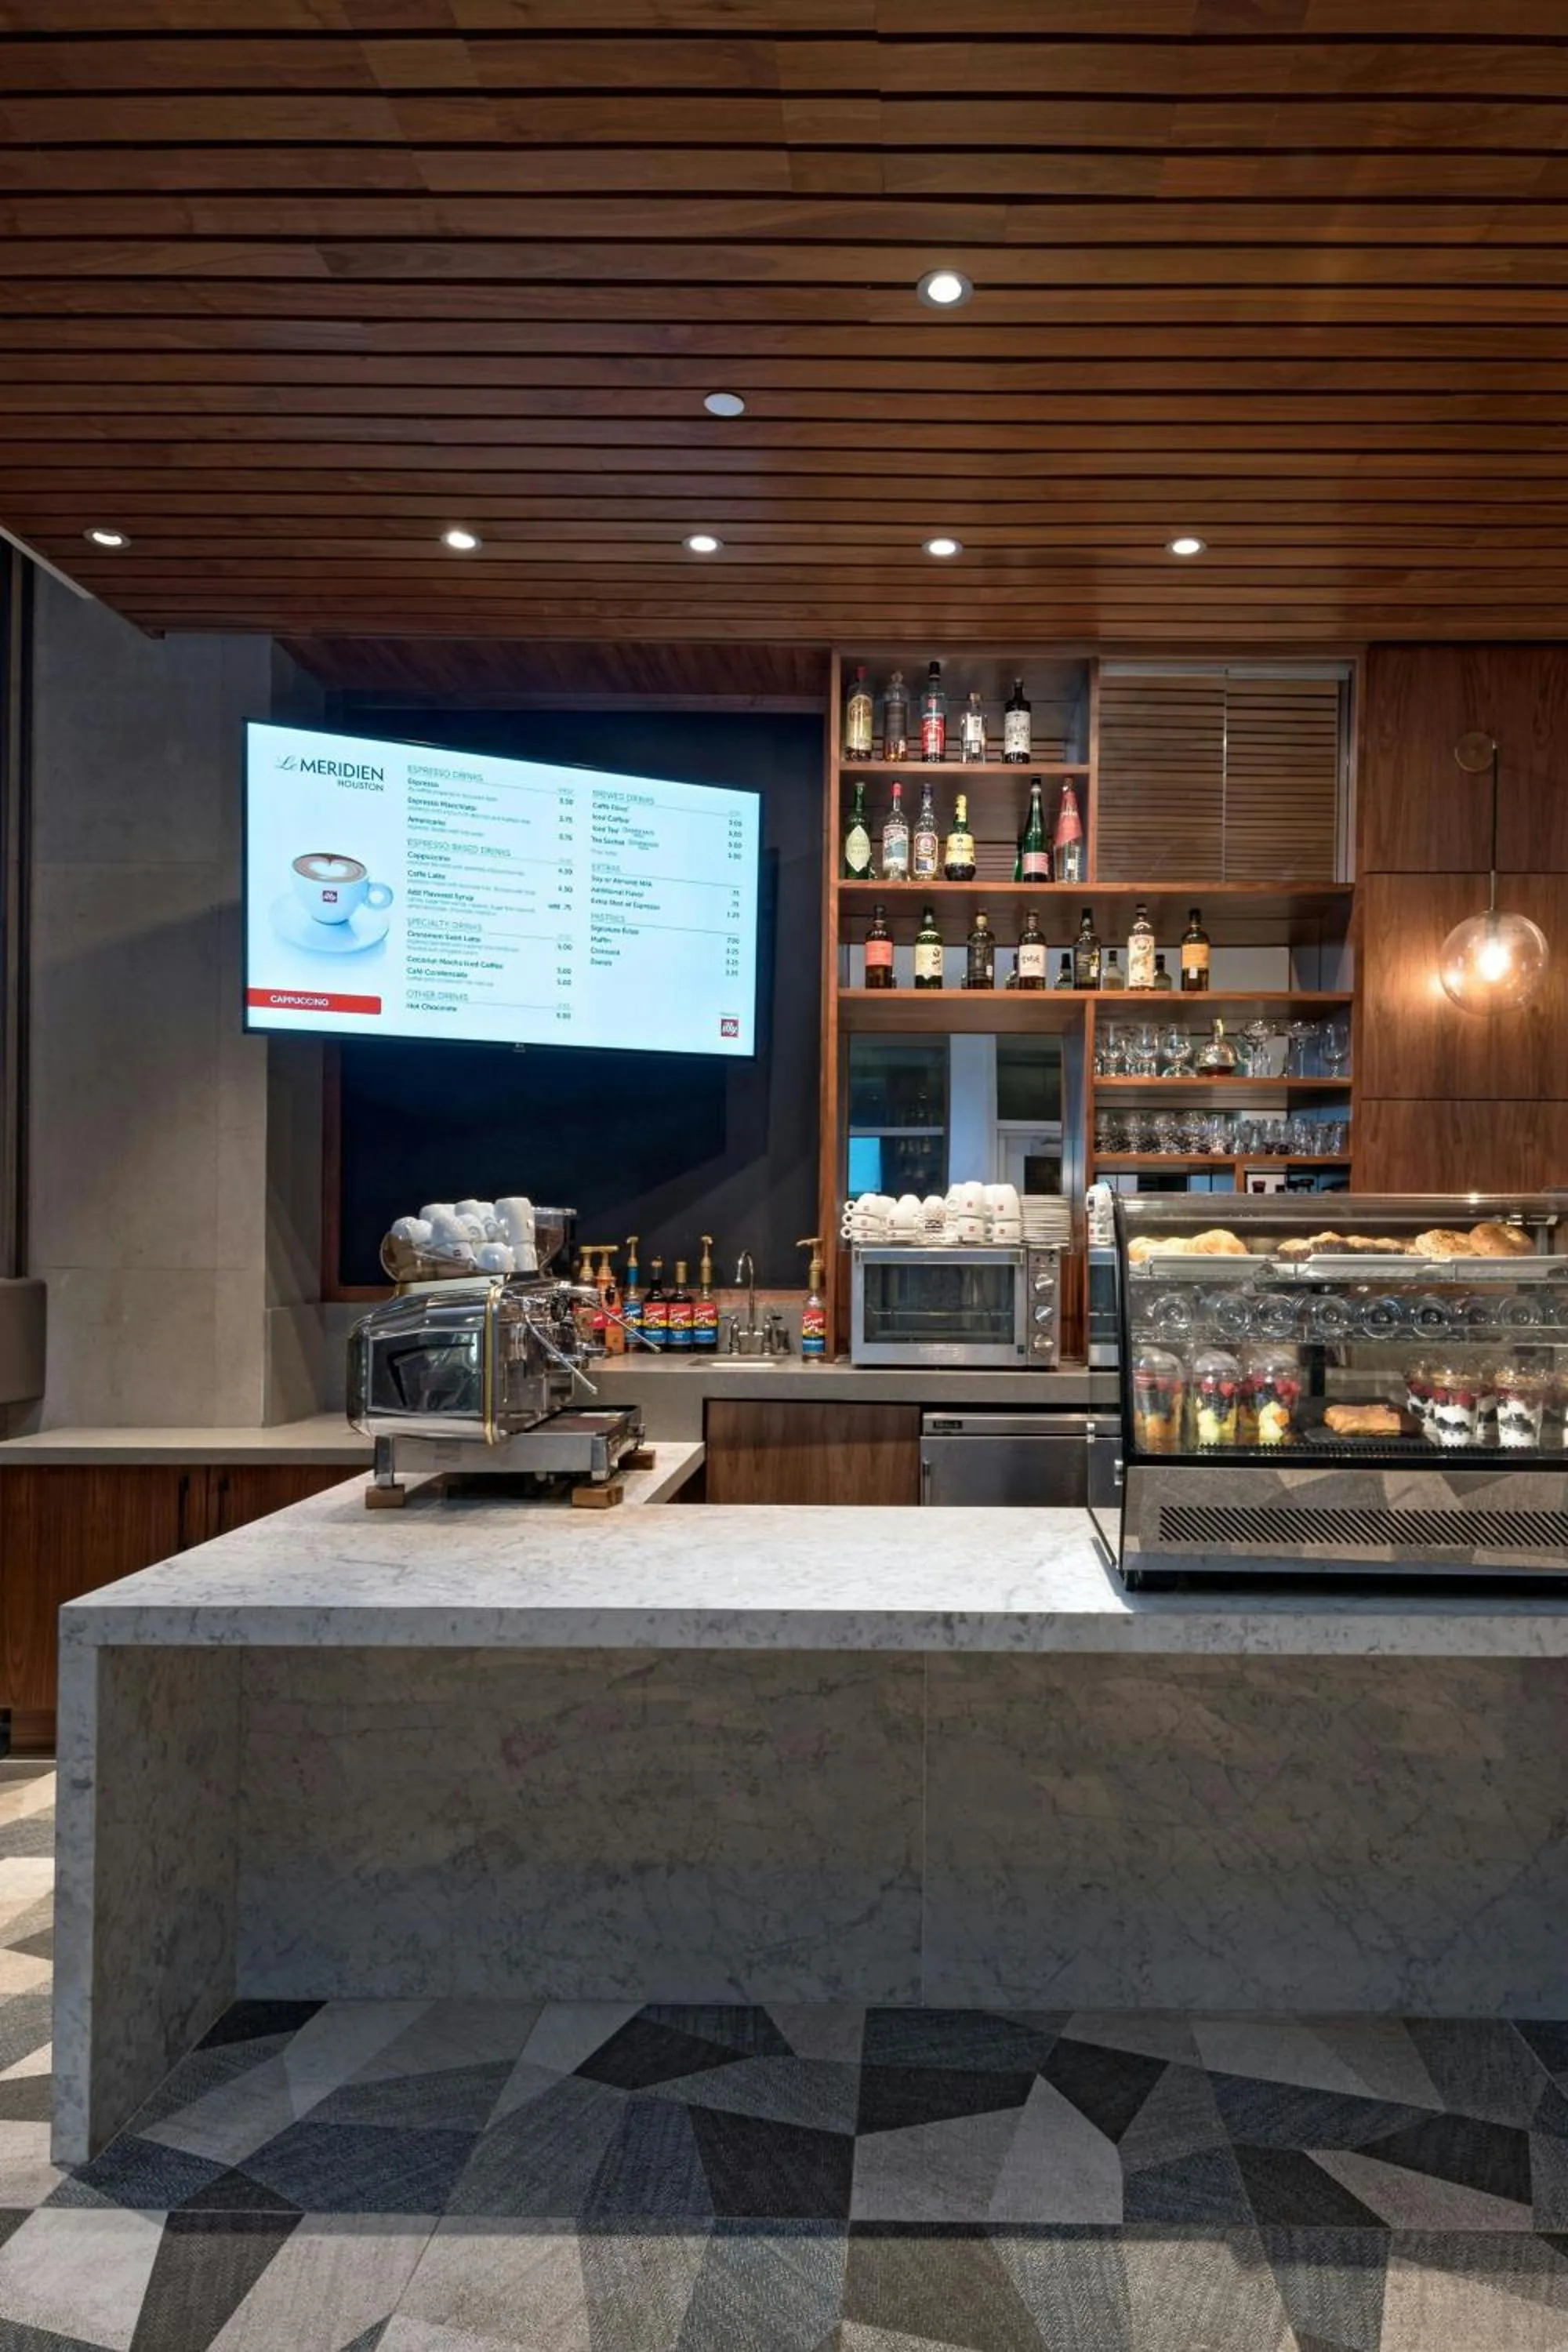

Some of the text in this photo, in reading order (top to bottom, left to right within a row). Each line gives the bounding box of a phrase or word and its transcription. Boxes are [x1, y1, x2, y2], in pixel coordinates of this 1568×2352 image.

[300, 759, 383, 780] MERIDIEN
[407, 764, 450, 779] ESPRESSO
[337, 779, 383, 791] HOUSTON
[407, 838, 450, 851] ESPRESSO
[407, 851, 451, 862] Cappuccino
[406, 989, 437, 1000] OTHER
[270, 995, 328, 1007] CAPPUCCINO
